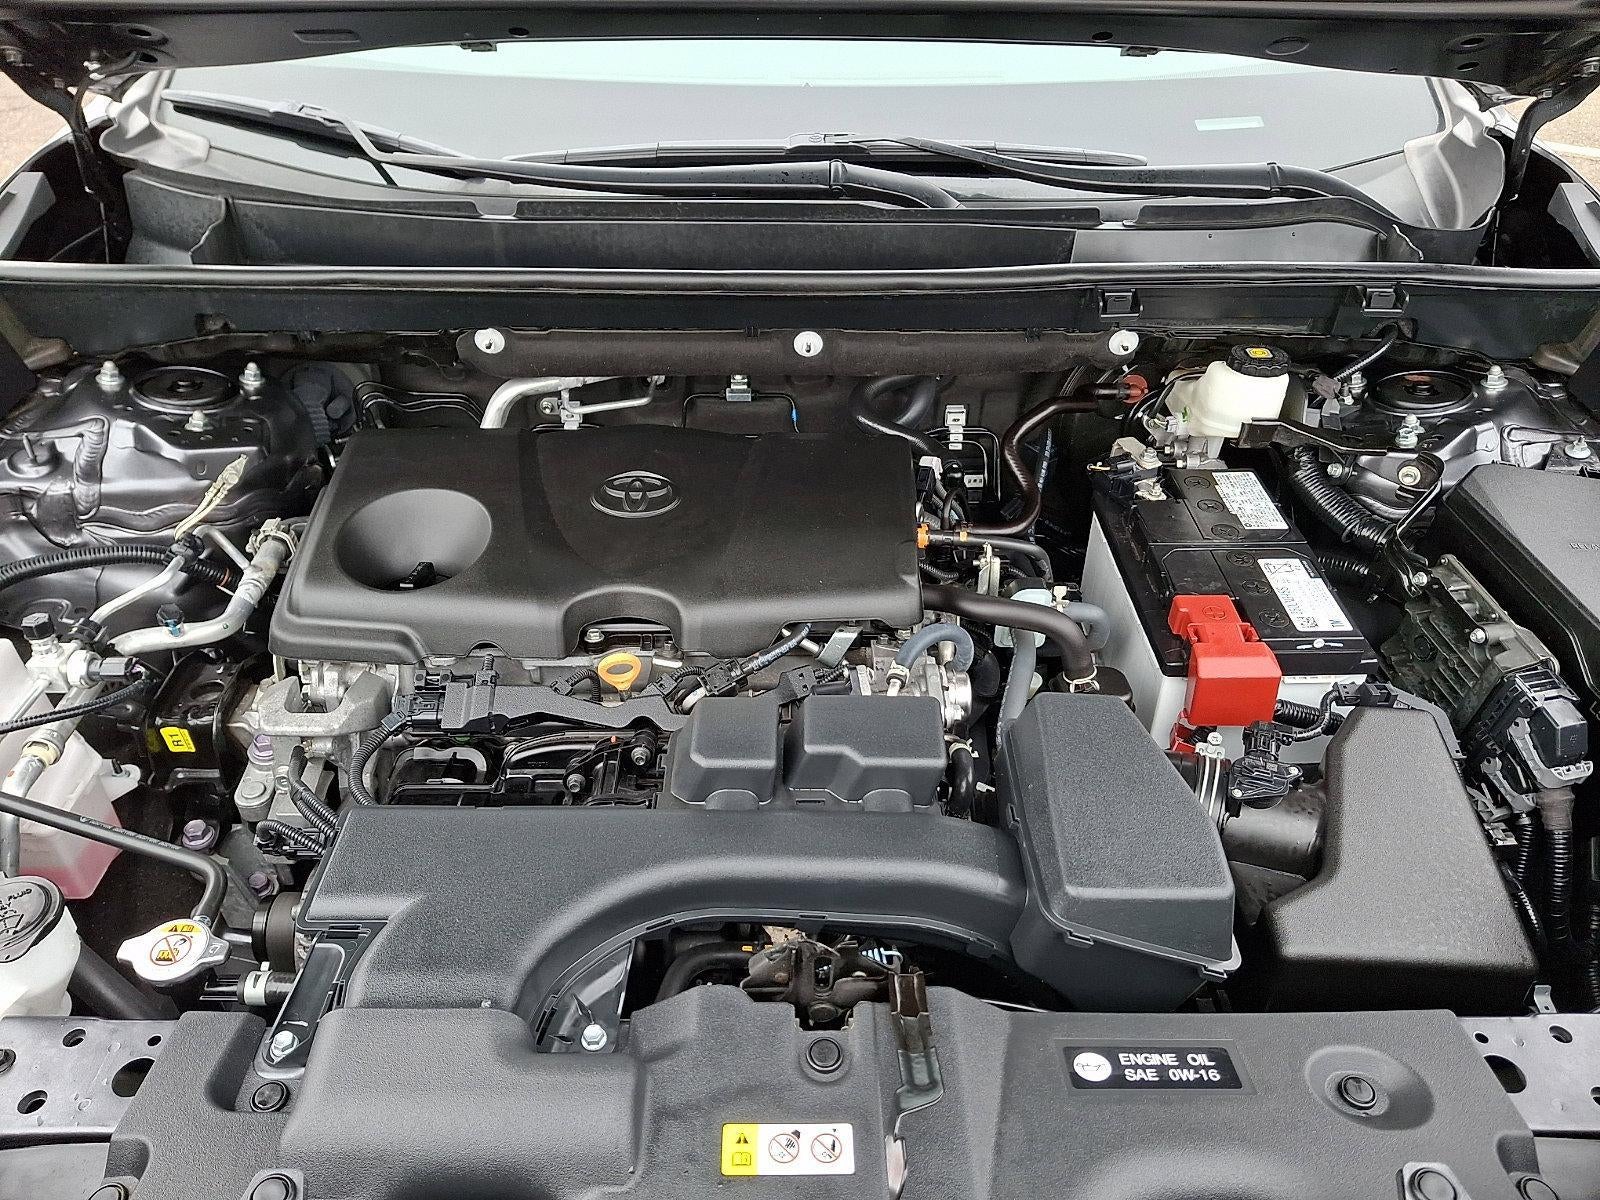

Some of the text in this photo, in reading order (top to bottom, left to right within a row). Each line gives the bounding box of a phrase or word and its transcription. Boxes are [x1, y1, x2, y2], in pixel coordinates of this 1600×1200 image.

[1118, 1053, 1216, 1066] ENGINE OIL
[1124, 1069, 1221, 1082] SAE 0W-16
